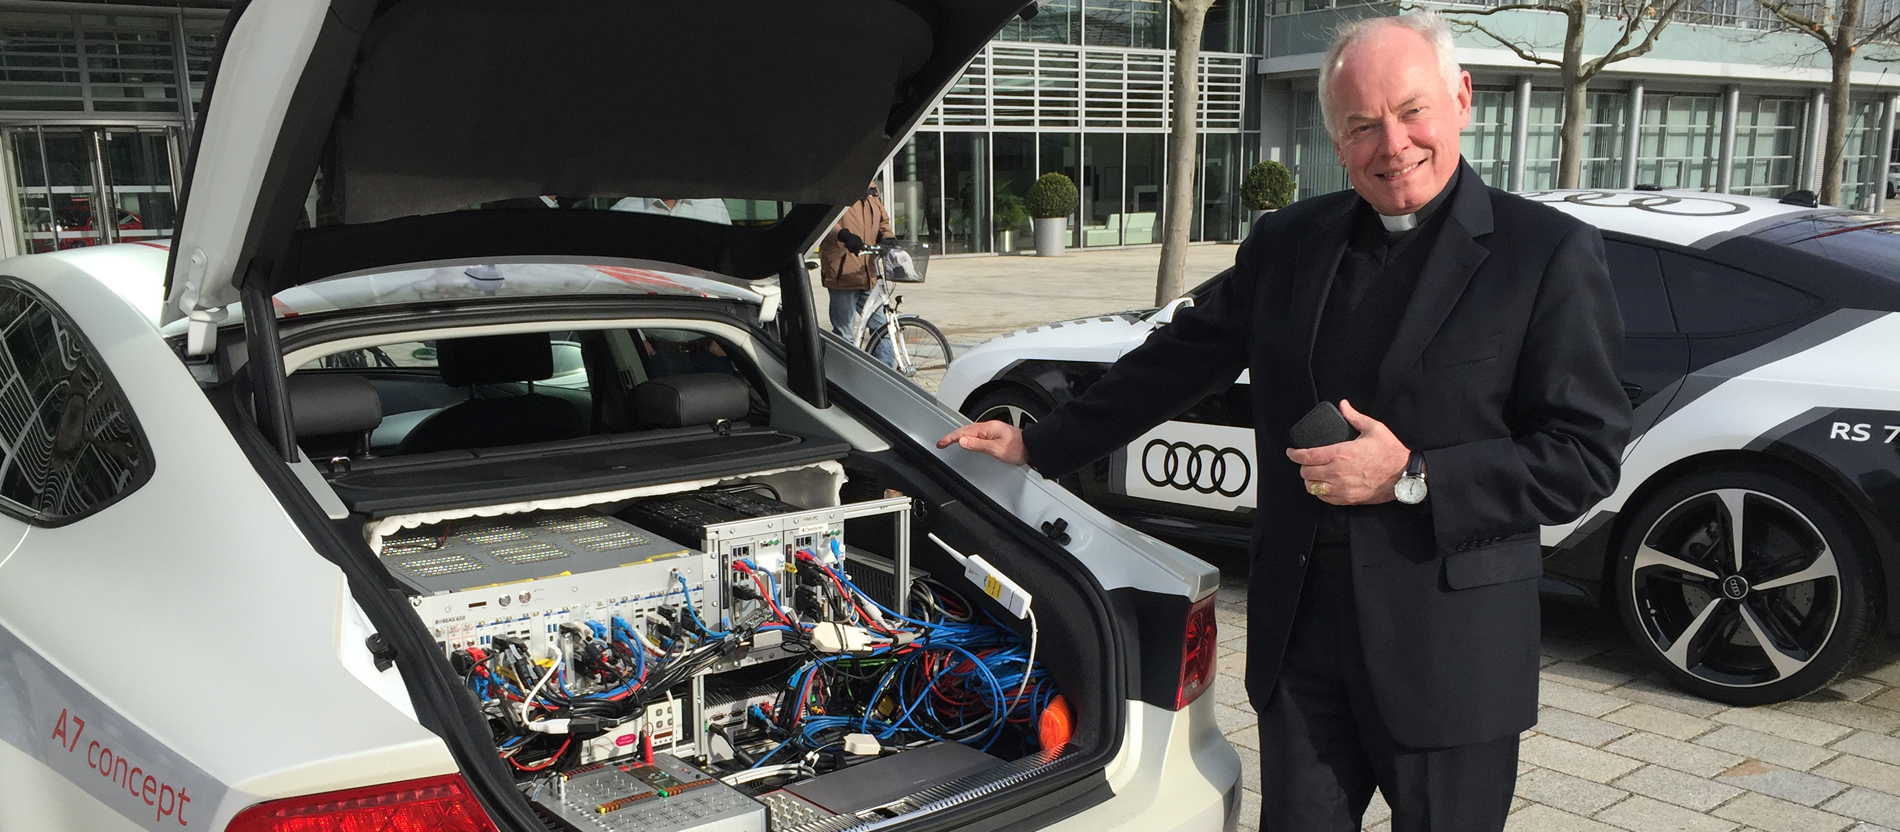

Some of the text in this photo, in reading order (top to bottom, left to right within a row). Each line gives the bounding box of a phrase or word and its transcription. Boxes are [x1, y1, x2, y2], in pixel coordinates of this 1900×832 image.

[1830, 421, 1900, 444] RS 7
[51, 707, 191, 827] A7 concept
